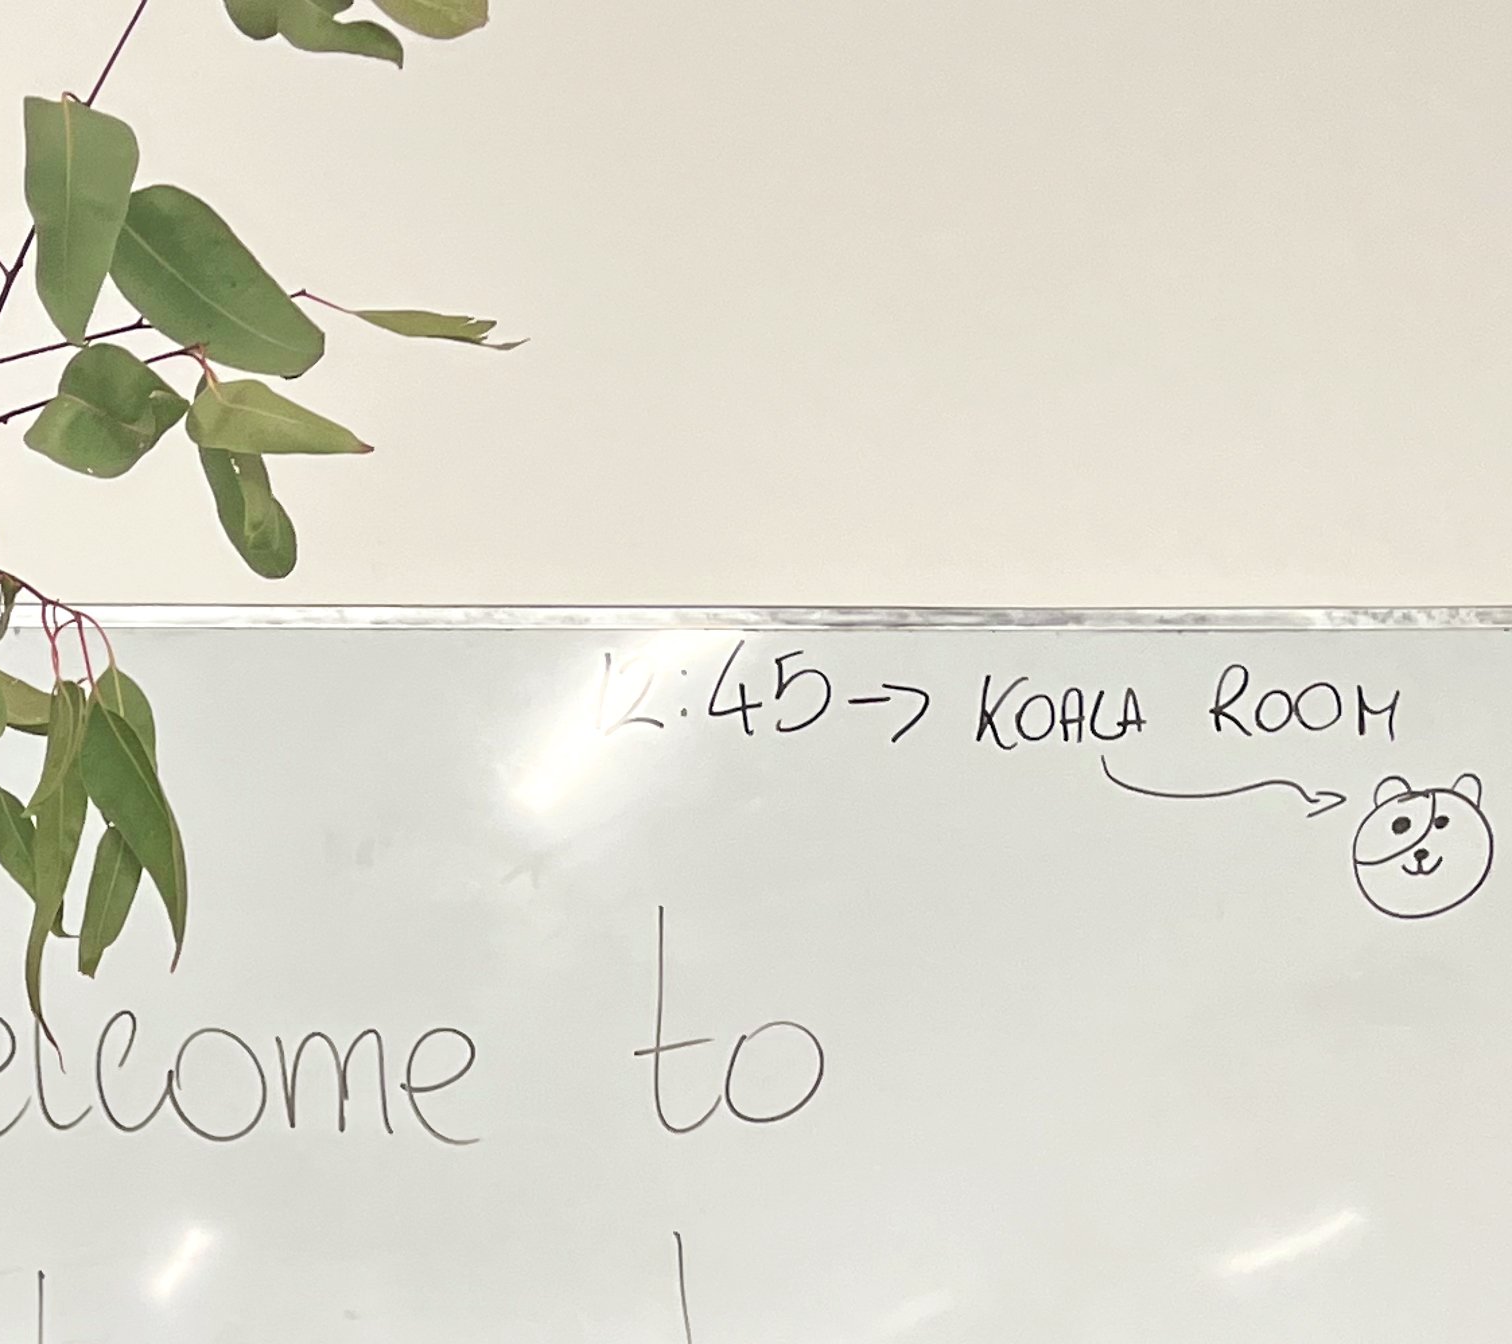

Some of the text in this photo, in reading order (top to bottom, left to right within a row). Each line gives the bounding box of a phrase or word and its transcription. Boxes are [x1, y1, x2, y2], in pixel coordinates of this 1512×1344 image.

[976, 674, 1147, 751] KOALA
[1208, 663, 1400, 742] ROOM
[633, 905, 826, 1134] to
